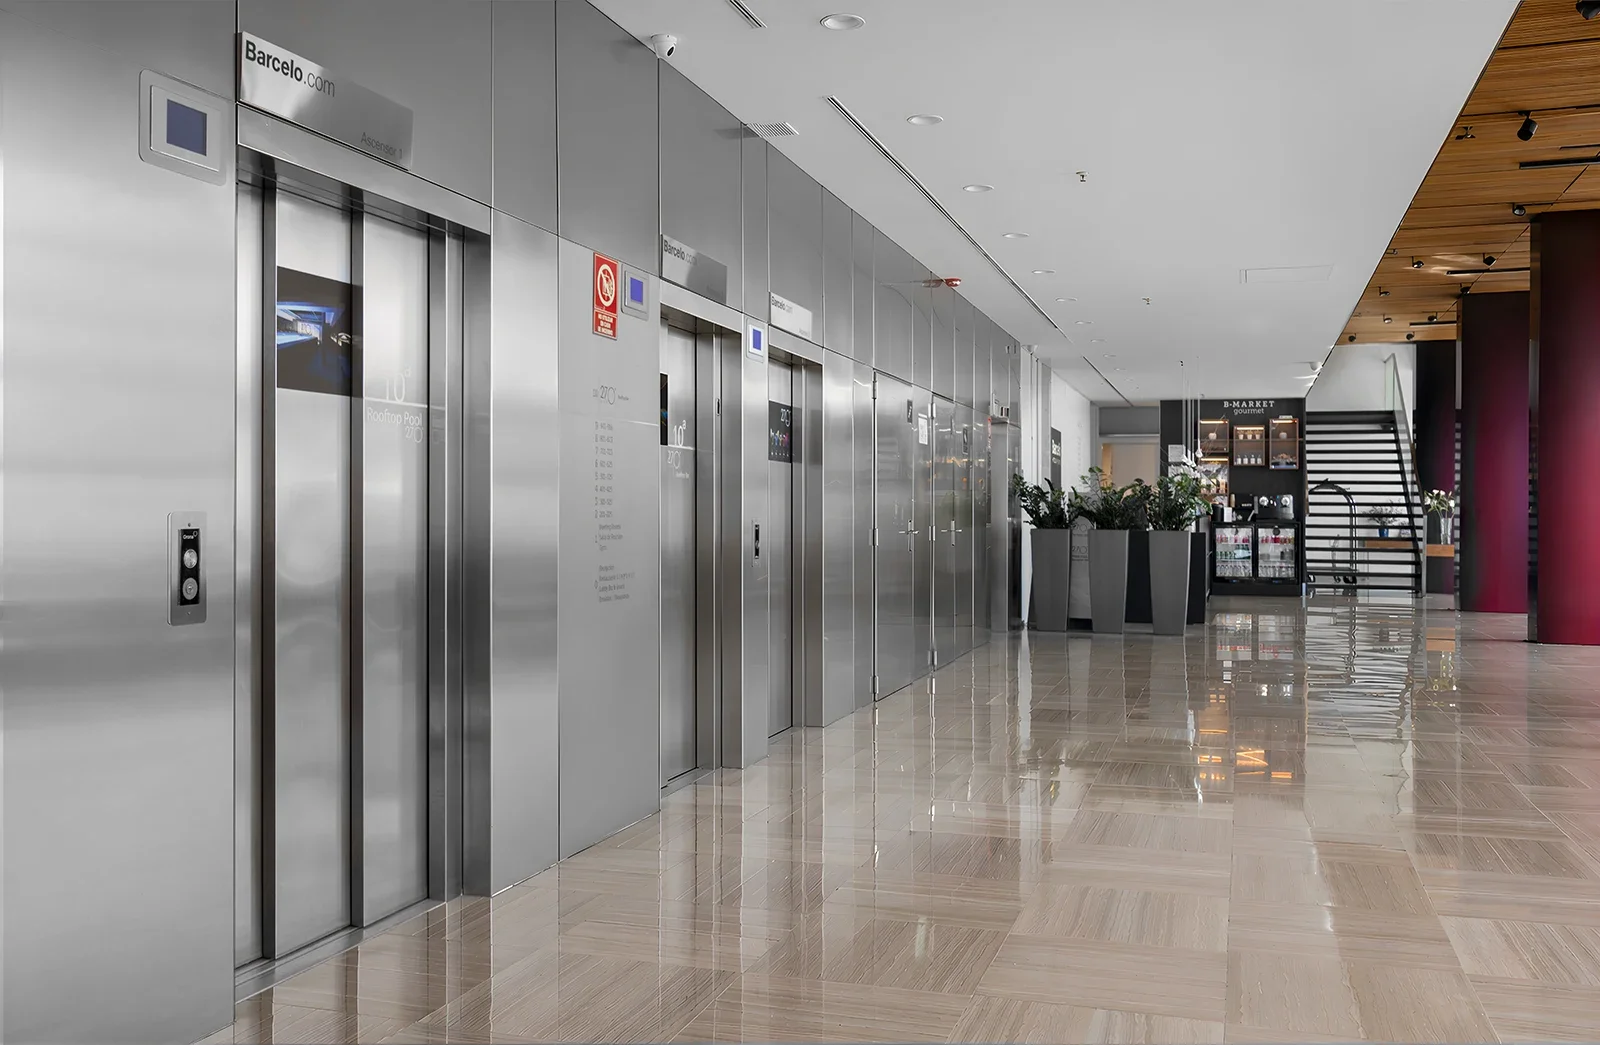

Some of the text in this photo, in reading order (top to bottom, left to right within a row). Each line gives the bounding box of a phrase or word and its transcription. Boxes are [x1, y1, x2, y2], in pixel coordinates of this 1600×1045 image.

[245, 39, 336, 98] Barcelo.com
[360, 131, 397, 157] Ascensor
[367, 407, 423, 427] Rooftop Pool
[1233, 407, 1265, 416] gourmet
